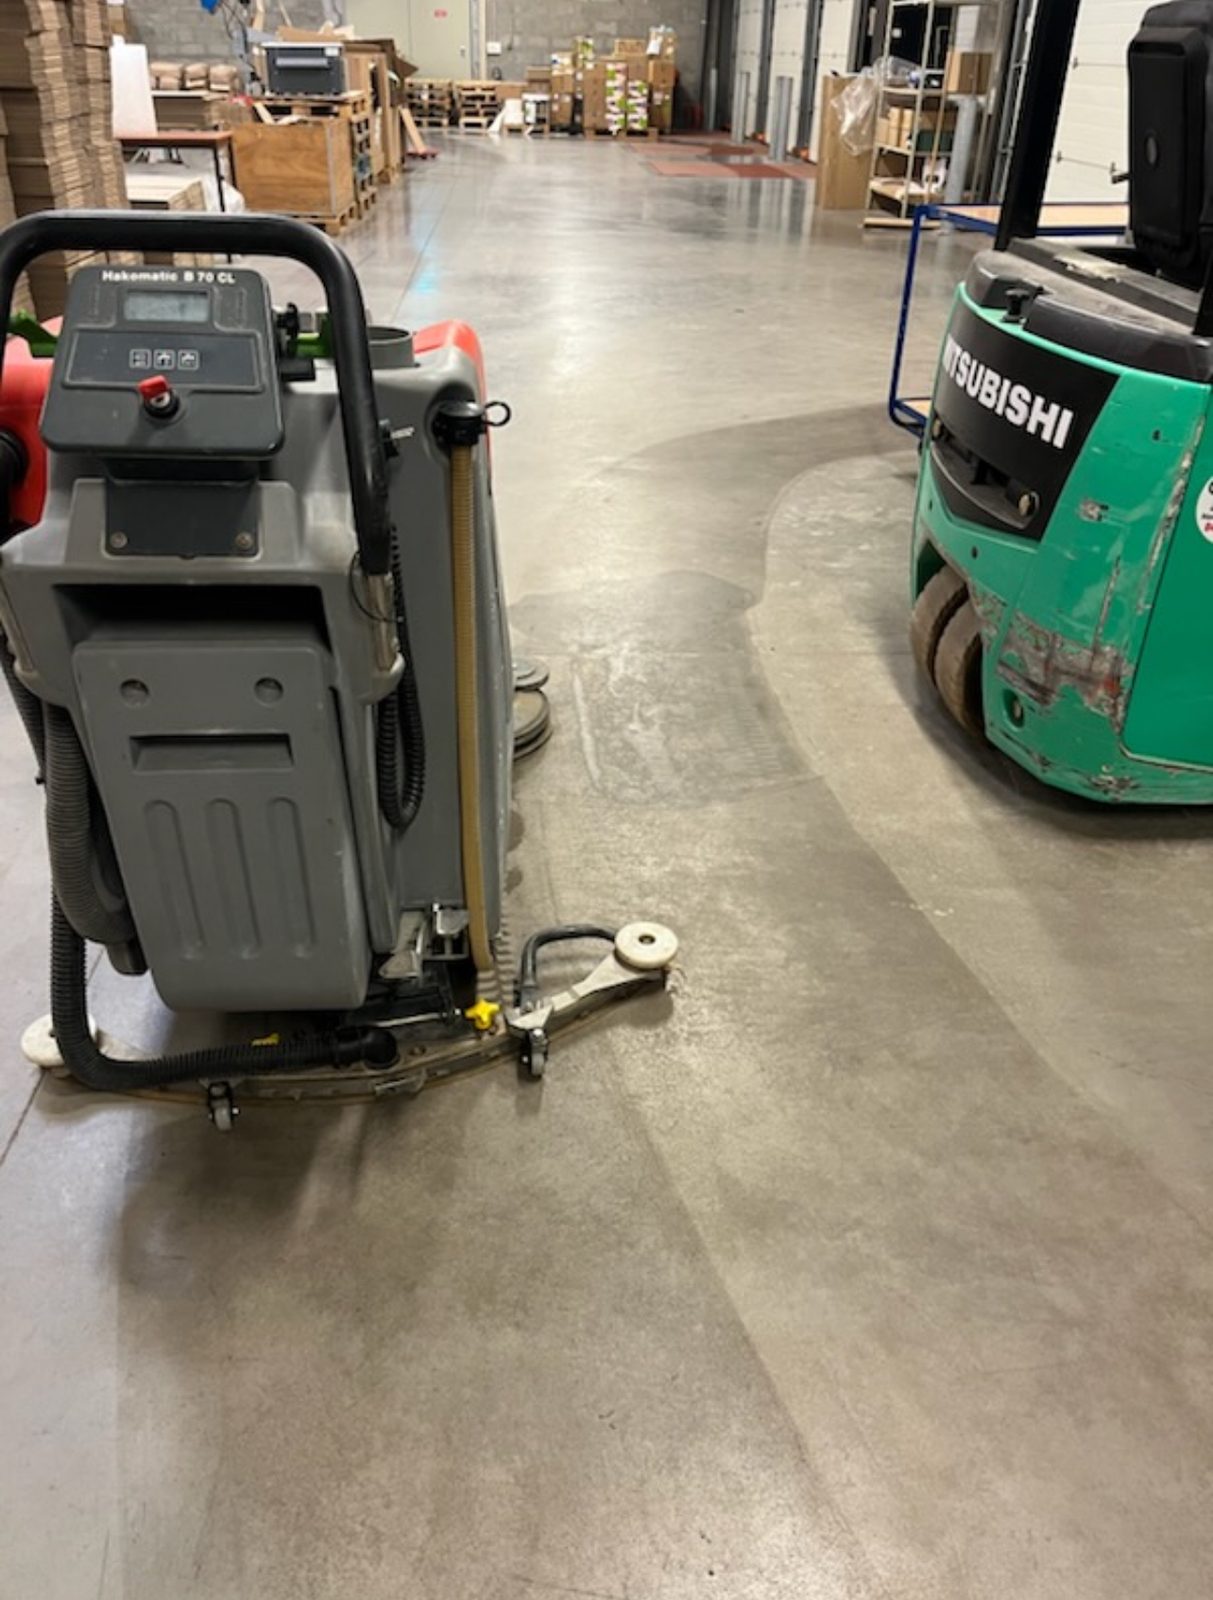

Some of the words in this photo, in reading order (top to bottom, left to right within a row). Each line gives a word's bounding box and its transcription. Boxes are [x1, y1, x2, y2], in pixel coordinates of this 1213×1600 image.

[102, 270, 178, 282] Hakomatic
[183, 270, 195, 283] B
[197, 271, 215, 284] 70
[217, 272, 236, 284] CL
[942, 333, 1074, 449] ITSUBISHI
